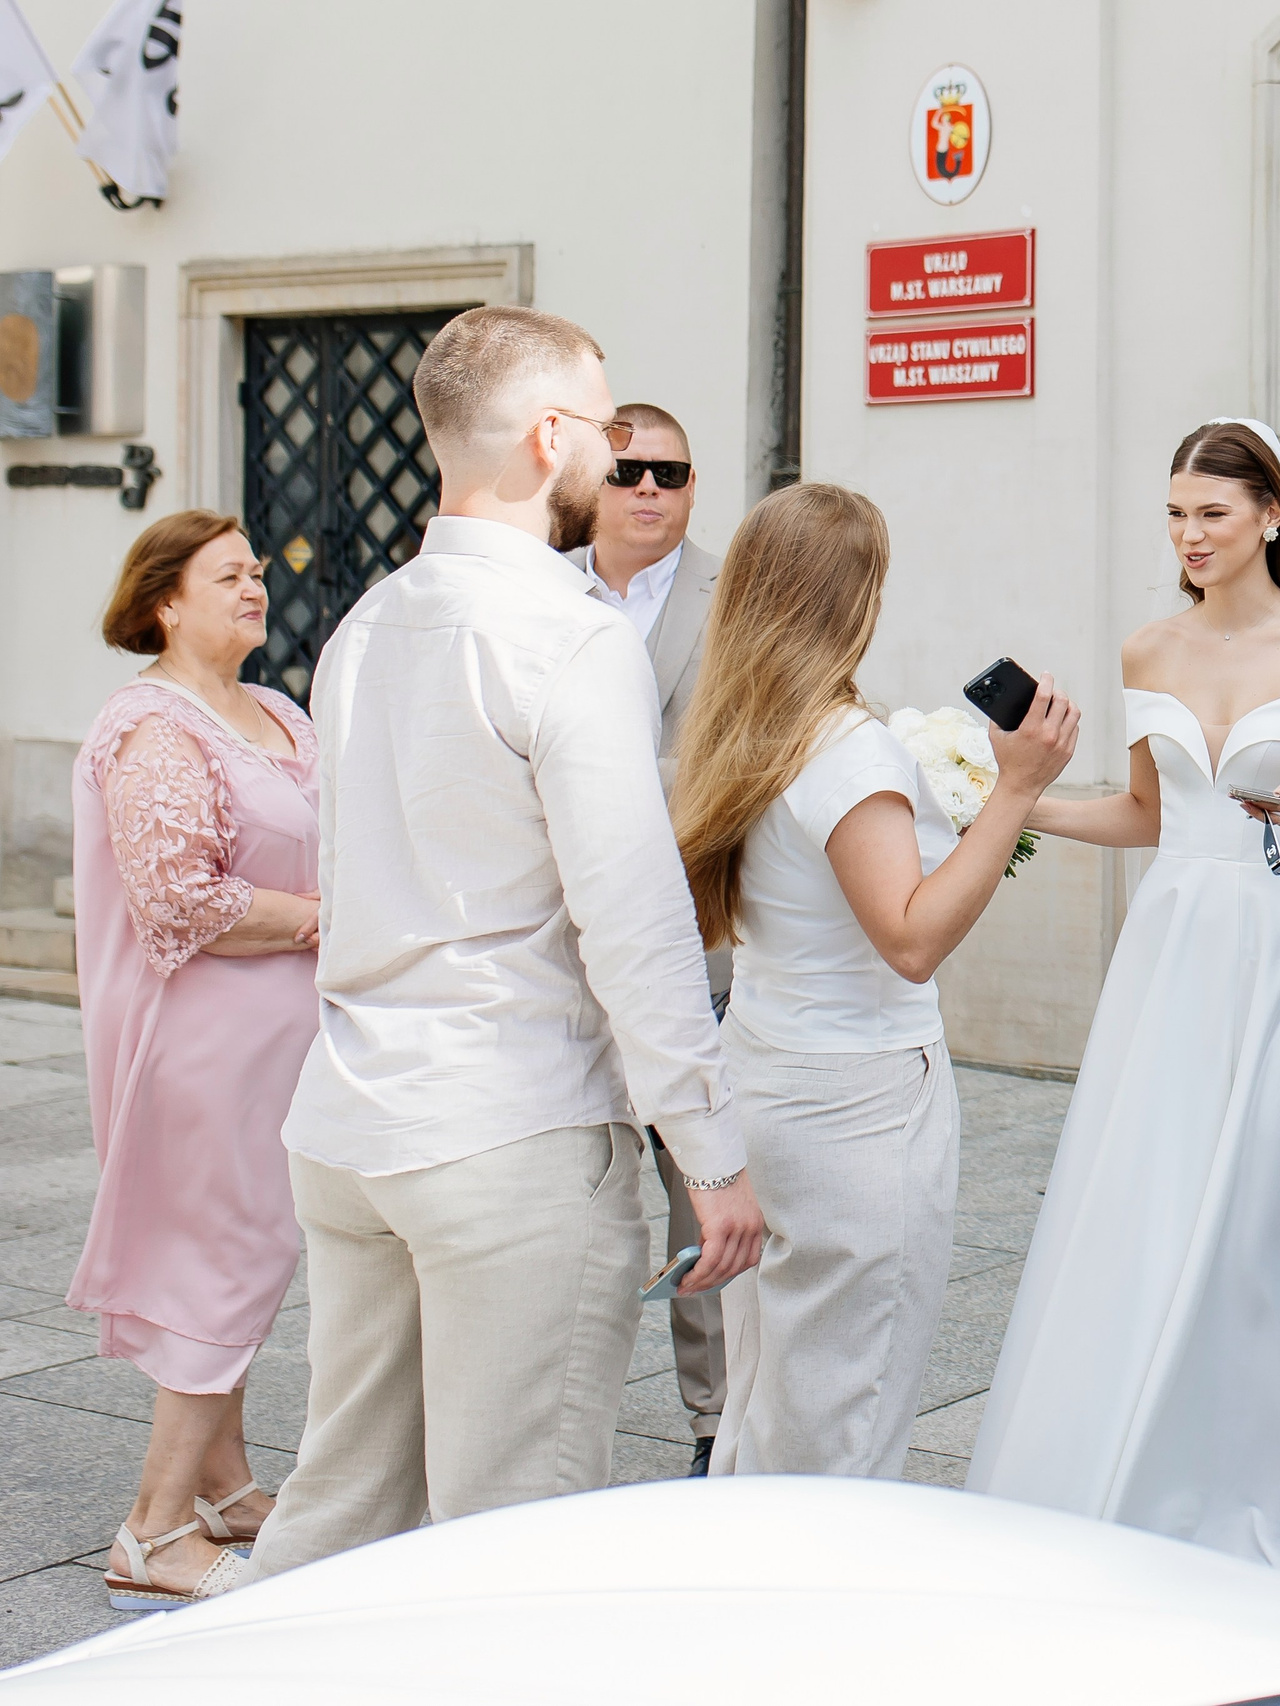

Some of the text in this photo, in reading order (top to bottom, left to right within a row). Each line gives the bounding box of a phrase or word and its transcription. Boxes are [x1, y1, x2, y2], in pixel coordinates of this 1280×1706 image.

[924, 251, 968, 275] URZĄD
[928, 273, 1003, 298] WARSZAWY
[870, 334, 1026, 366] URZĄD STANU CYWILNEGO
[928, 362, 999, 385] WARSZAWY
